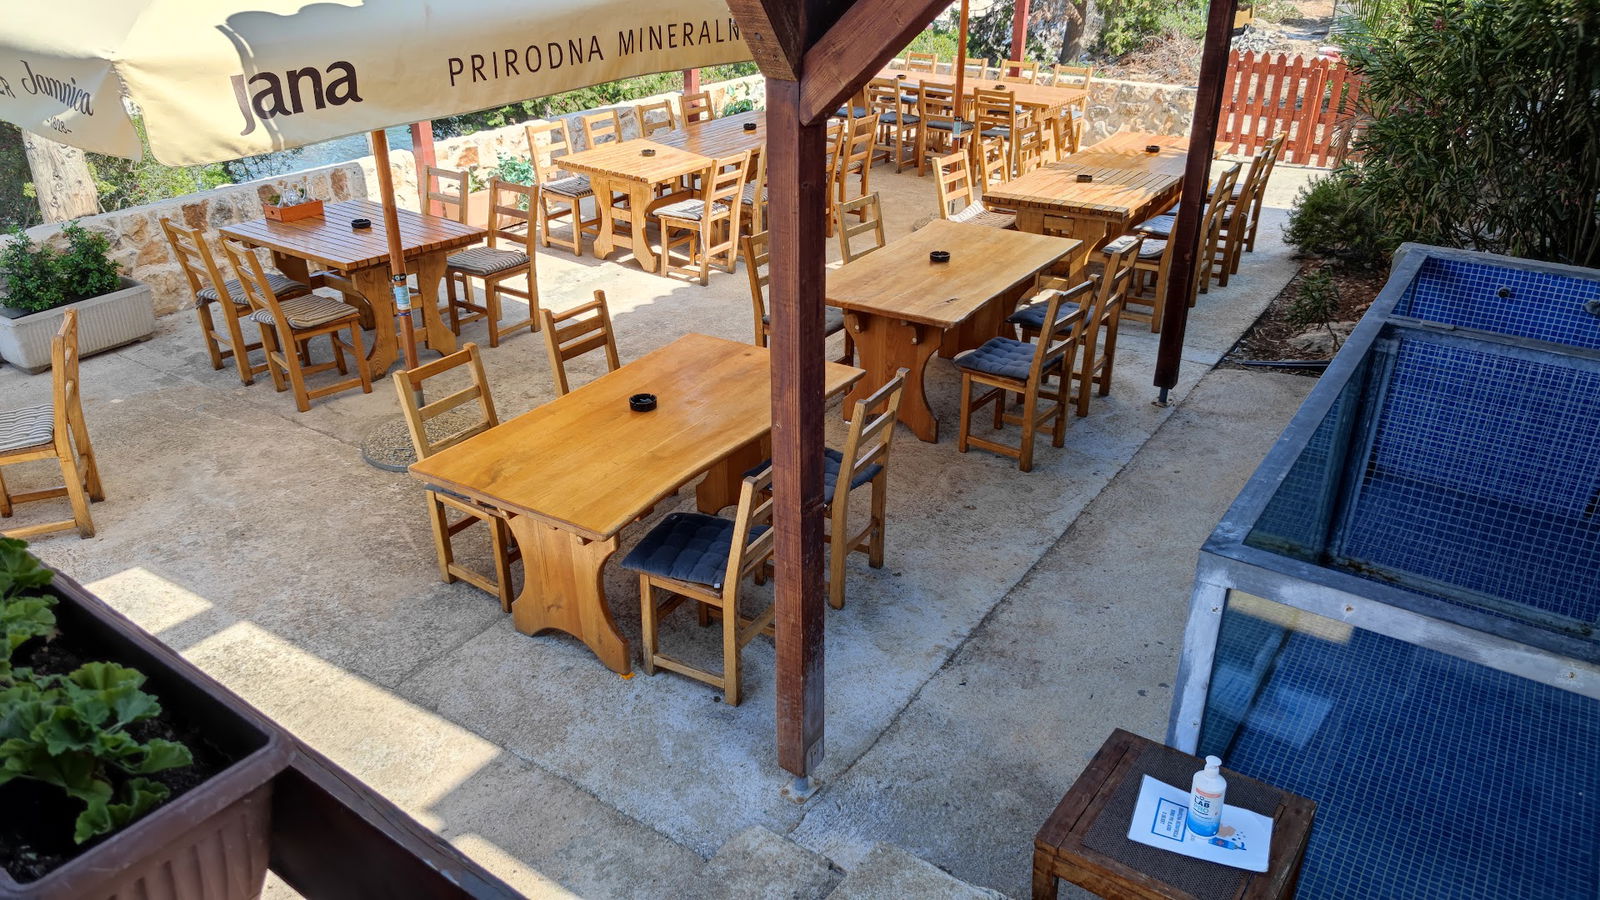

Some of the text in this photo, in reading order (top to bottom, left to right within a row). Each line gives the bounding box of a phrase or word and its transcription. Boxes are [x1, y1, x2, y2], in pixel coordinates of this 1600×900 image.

[448, 17, 740, 87] PRIRODNA MINERALN
[20, 59, 94, 117] Jamnica
